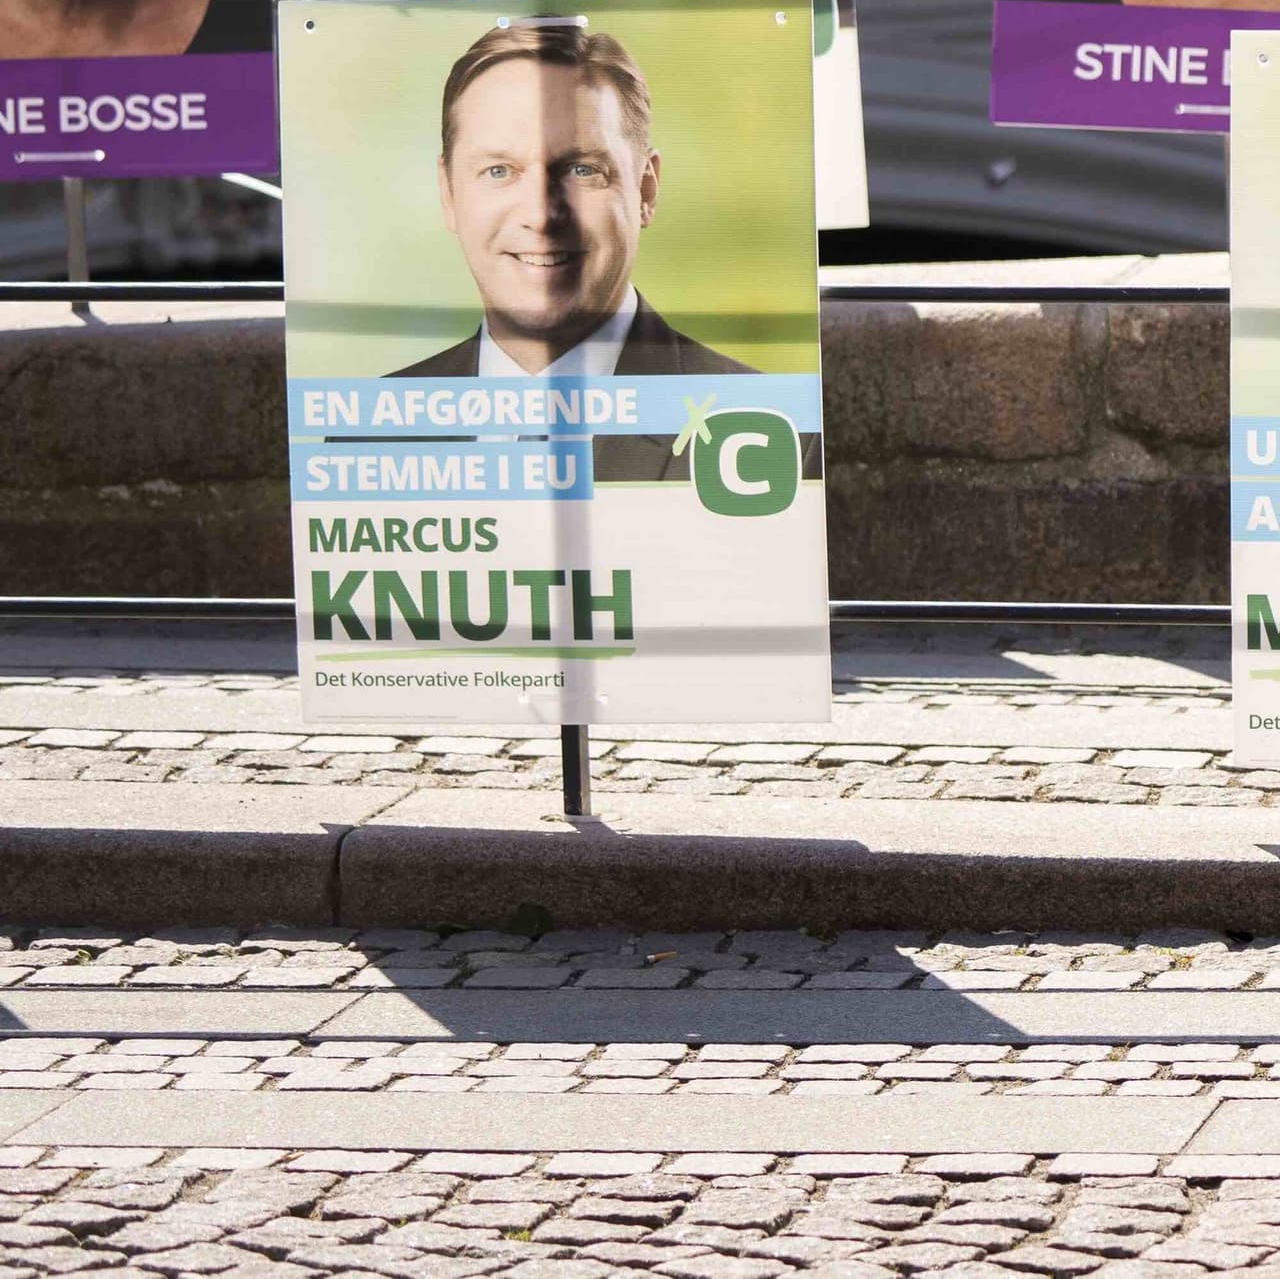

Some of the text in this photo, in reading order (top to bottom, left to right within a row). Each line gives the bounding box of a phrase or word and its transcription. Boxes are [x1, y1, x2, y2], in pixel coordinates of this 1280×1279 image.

[1075, 42, 1208, 84] STINE
[59, 92, 207, 133] BOSSE
[303, 387, 638, 428] EN AFGØRENDE
[306, 454, 576, 492] STEMME I EU
[718, 431, 770, 495] C
[308, 516, 499, 553] MARCUS
[310, 568, 634, 642] KNUTH
[315, 670, 565, 693] Det Konservative Folkeparti
[1249, 713, 1280, 731] Det
